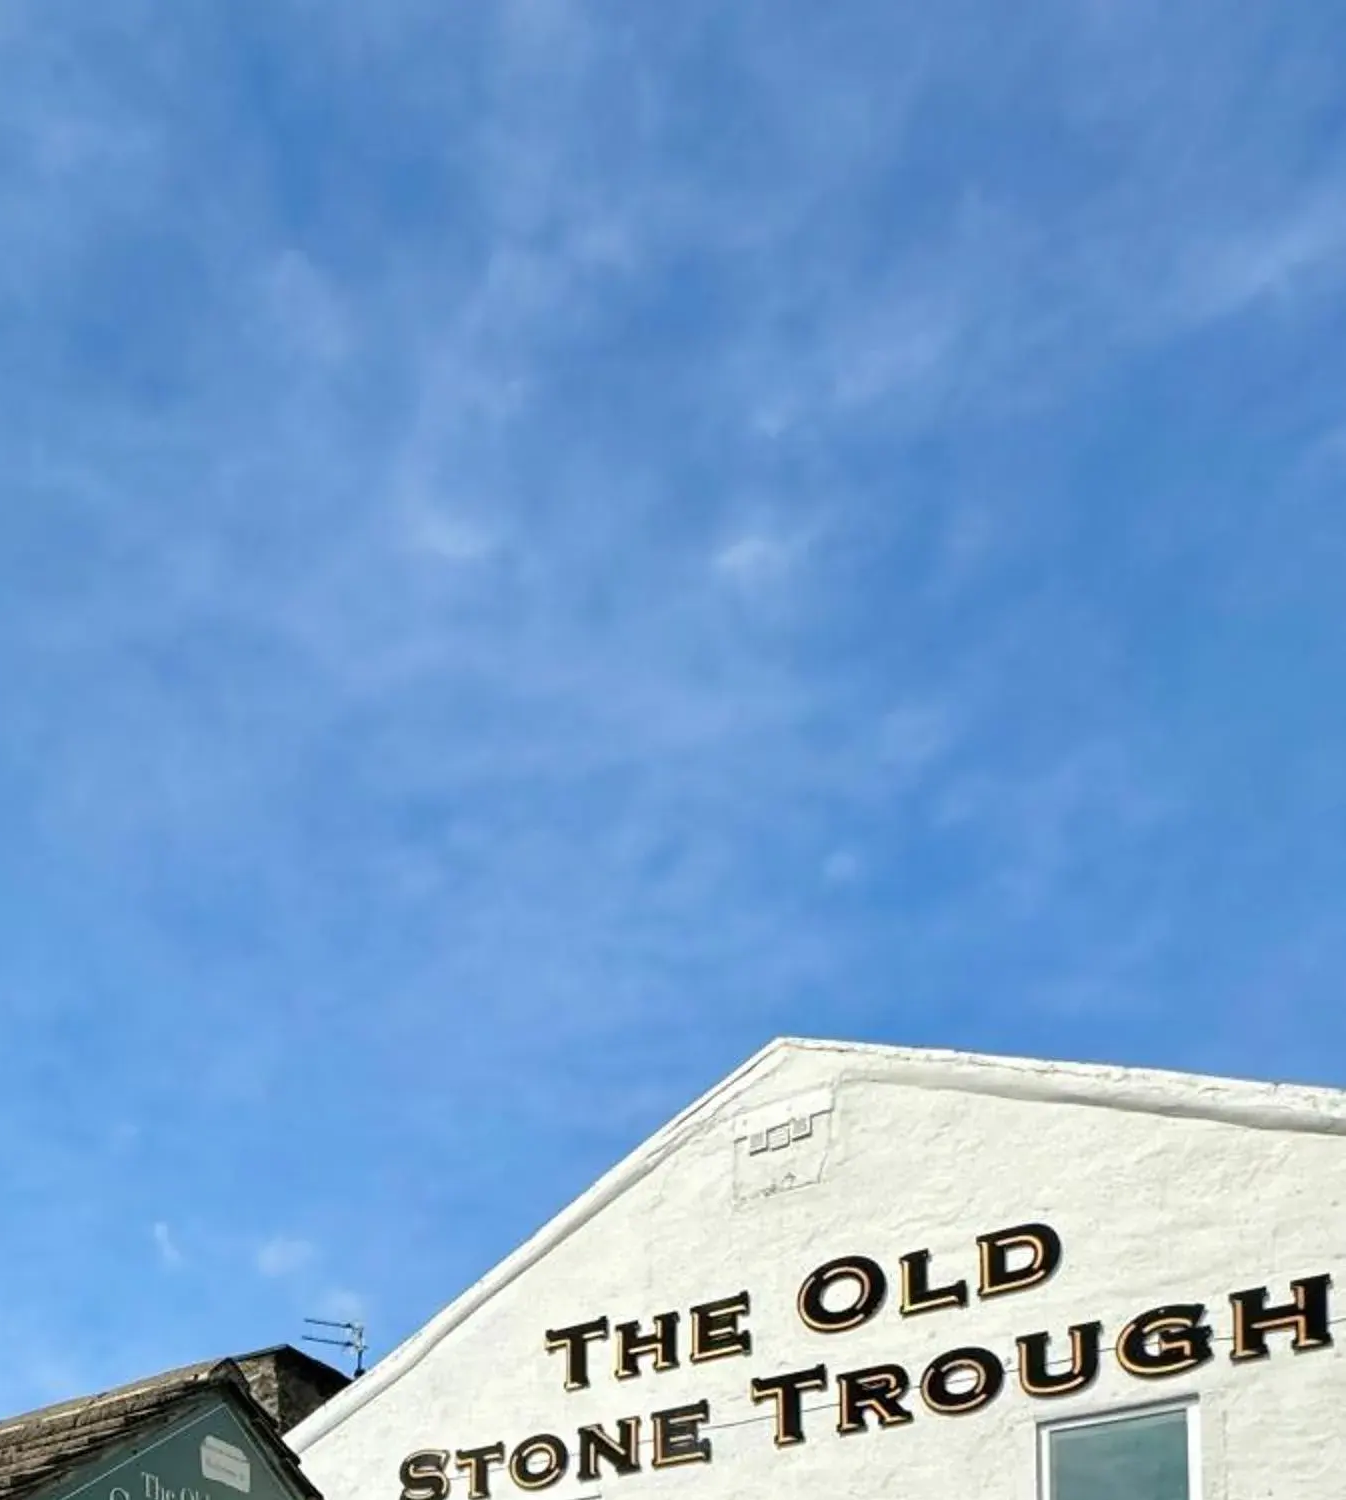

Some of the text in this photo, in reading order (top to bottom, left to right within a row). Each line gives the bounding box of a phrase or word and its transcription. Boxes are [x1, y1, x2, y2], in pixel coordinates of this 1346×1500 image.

[545, 1223, 1062, 1391] THE OLD
[751, 1273, 1334, 1449] TROUGH
